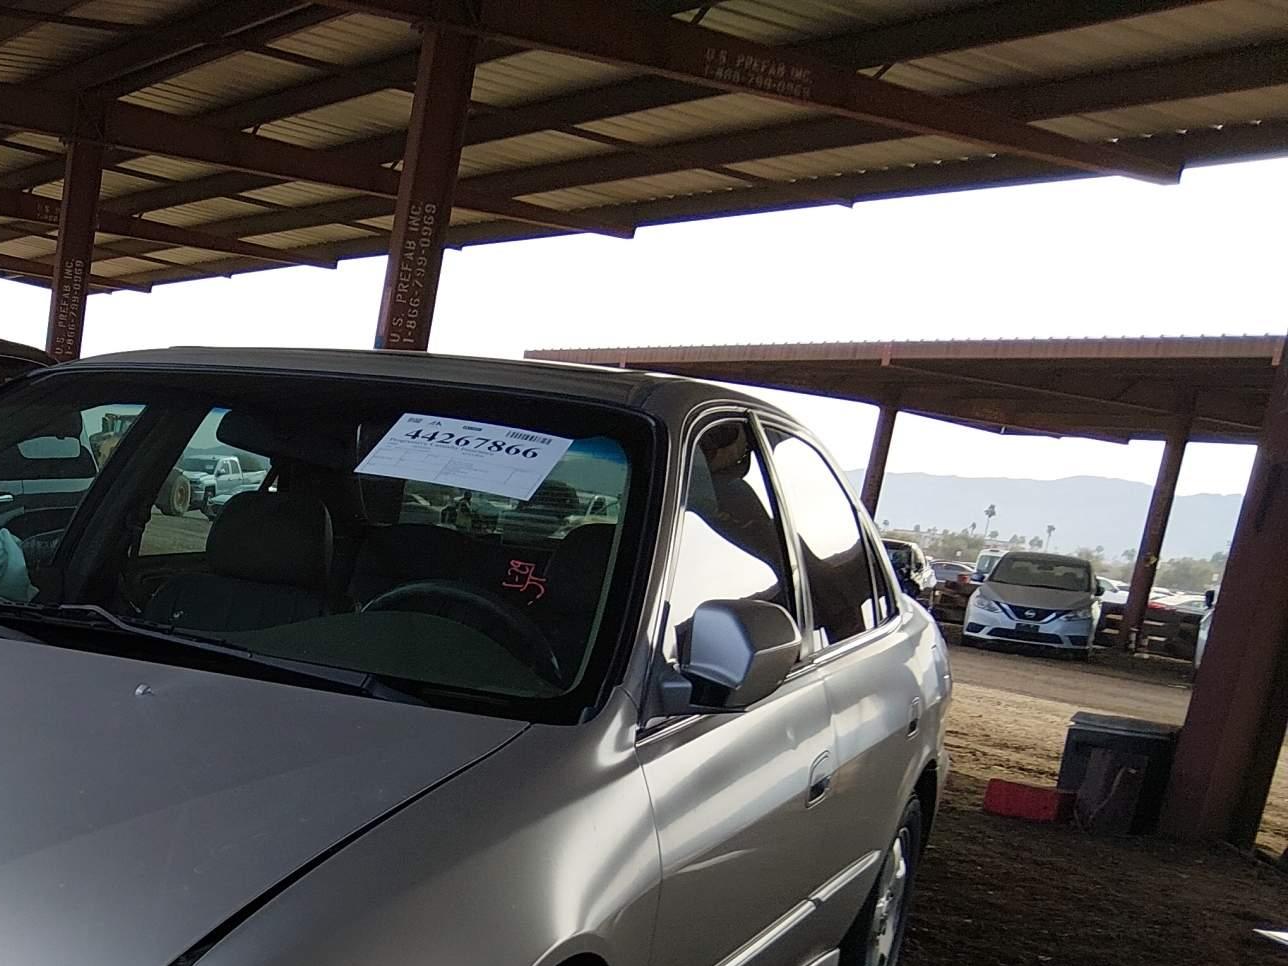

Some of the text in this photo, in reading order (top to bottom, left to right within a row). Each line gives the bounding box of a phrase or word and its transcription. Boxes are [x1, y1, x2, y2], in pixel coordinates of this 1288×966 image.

[57, 283, 72, 327] PREFAB
[65, 258, 75, 279] INC.
[395, 239, 418, 304] PREFAB
[407, 200, 424, 232] INC.
[402, 203, 437, 344] 1-866-799-0969
[405, 428, 539, 459] 44267866
